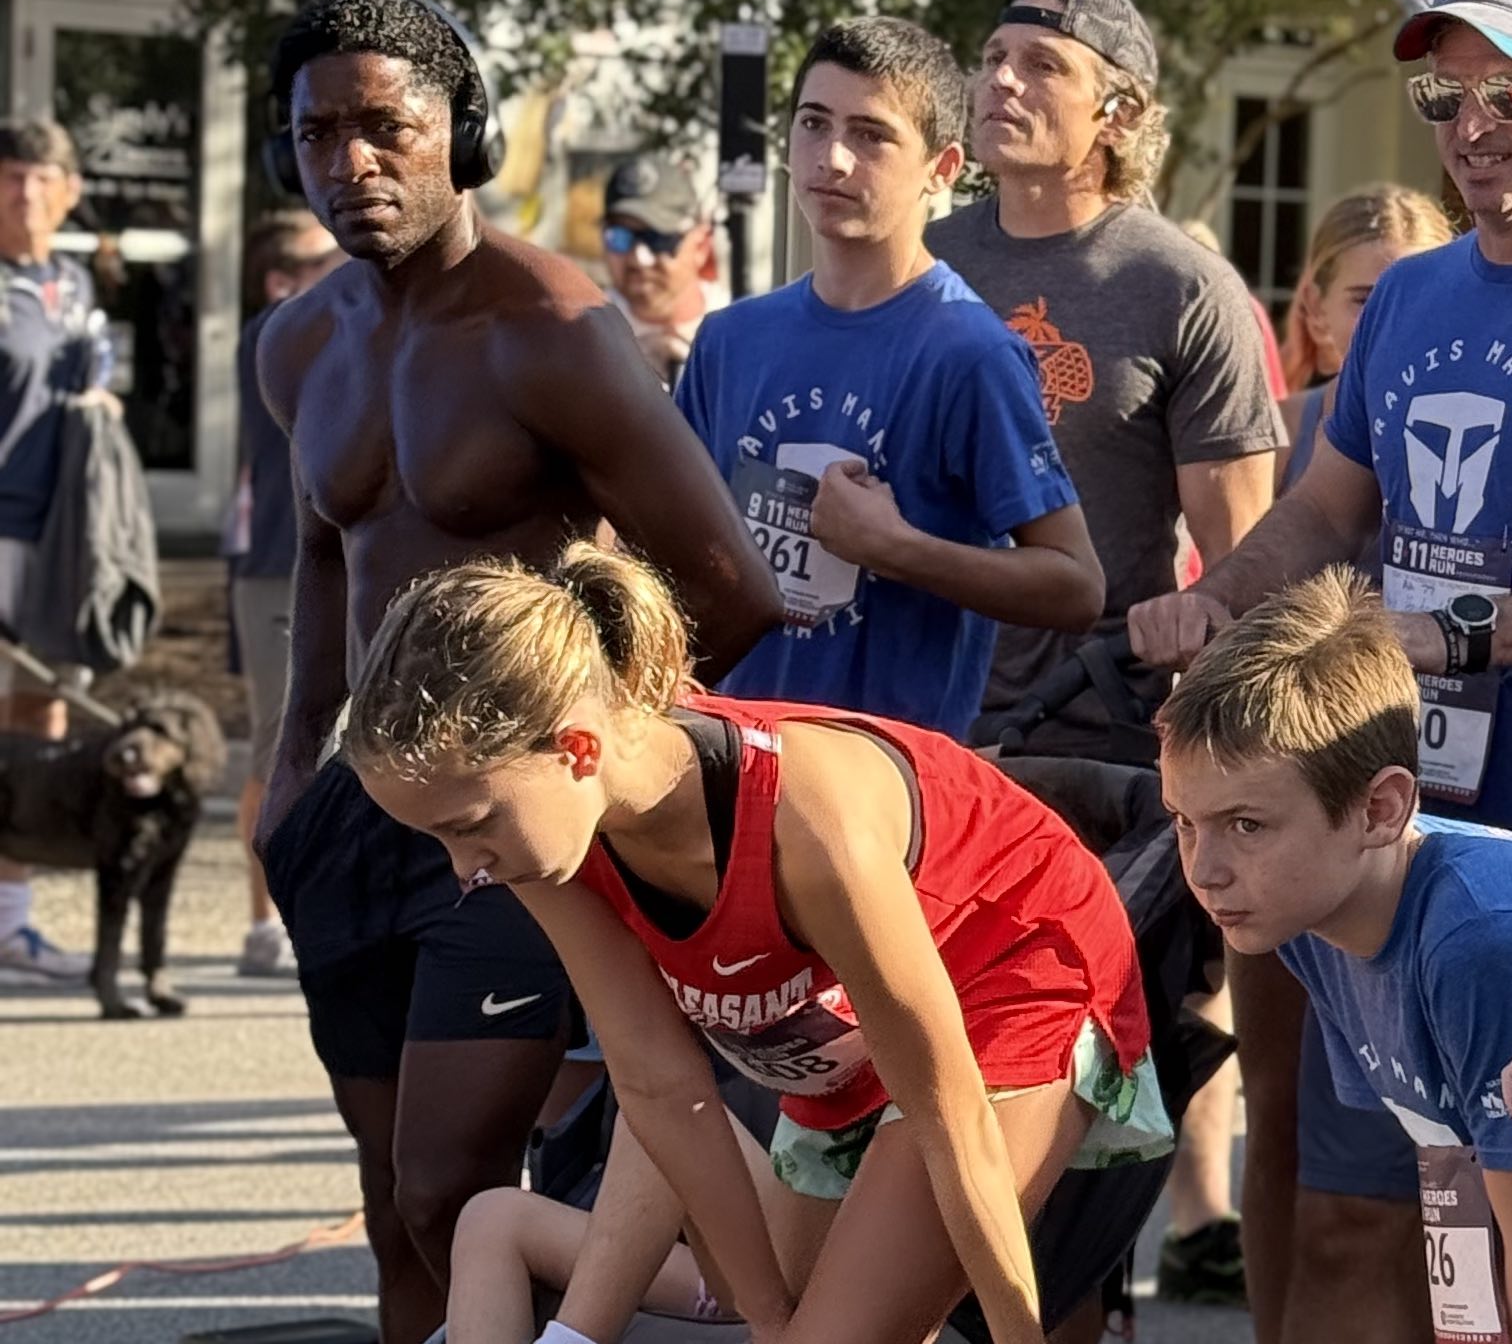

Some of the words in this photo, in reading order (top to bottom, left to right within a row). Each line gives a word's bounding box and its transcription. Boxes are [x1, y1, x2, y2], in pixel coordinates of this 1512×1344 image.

[1373, 339, 1464, 461] RAVIS
[767, 499, 785, 526] 11
[785, 517, 809, 534] RUN
[1393, 536, 1403, 564] 9
[1410, 541, 1428, 569] 11
[1431, 544, 1484, 566] HEROES
[1429, 559, 1455, 575] RUN
[1418, 708, 1447, 750] 0
[1422, 1190, 1458, 1207] HEROES
[1425, 1231, 1456, 1288] 26
